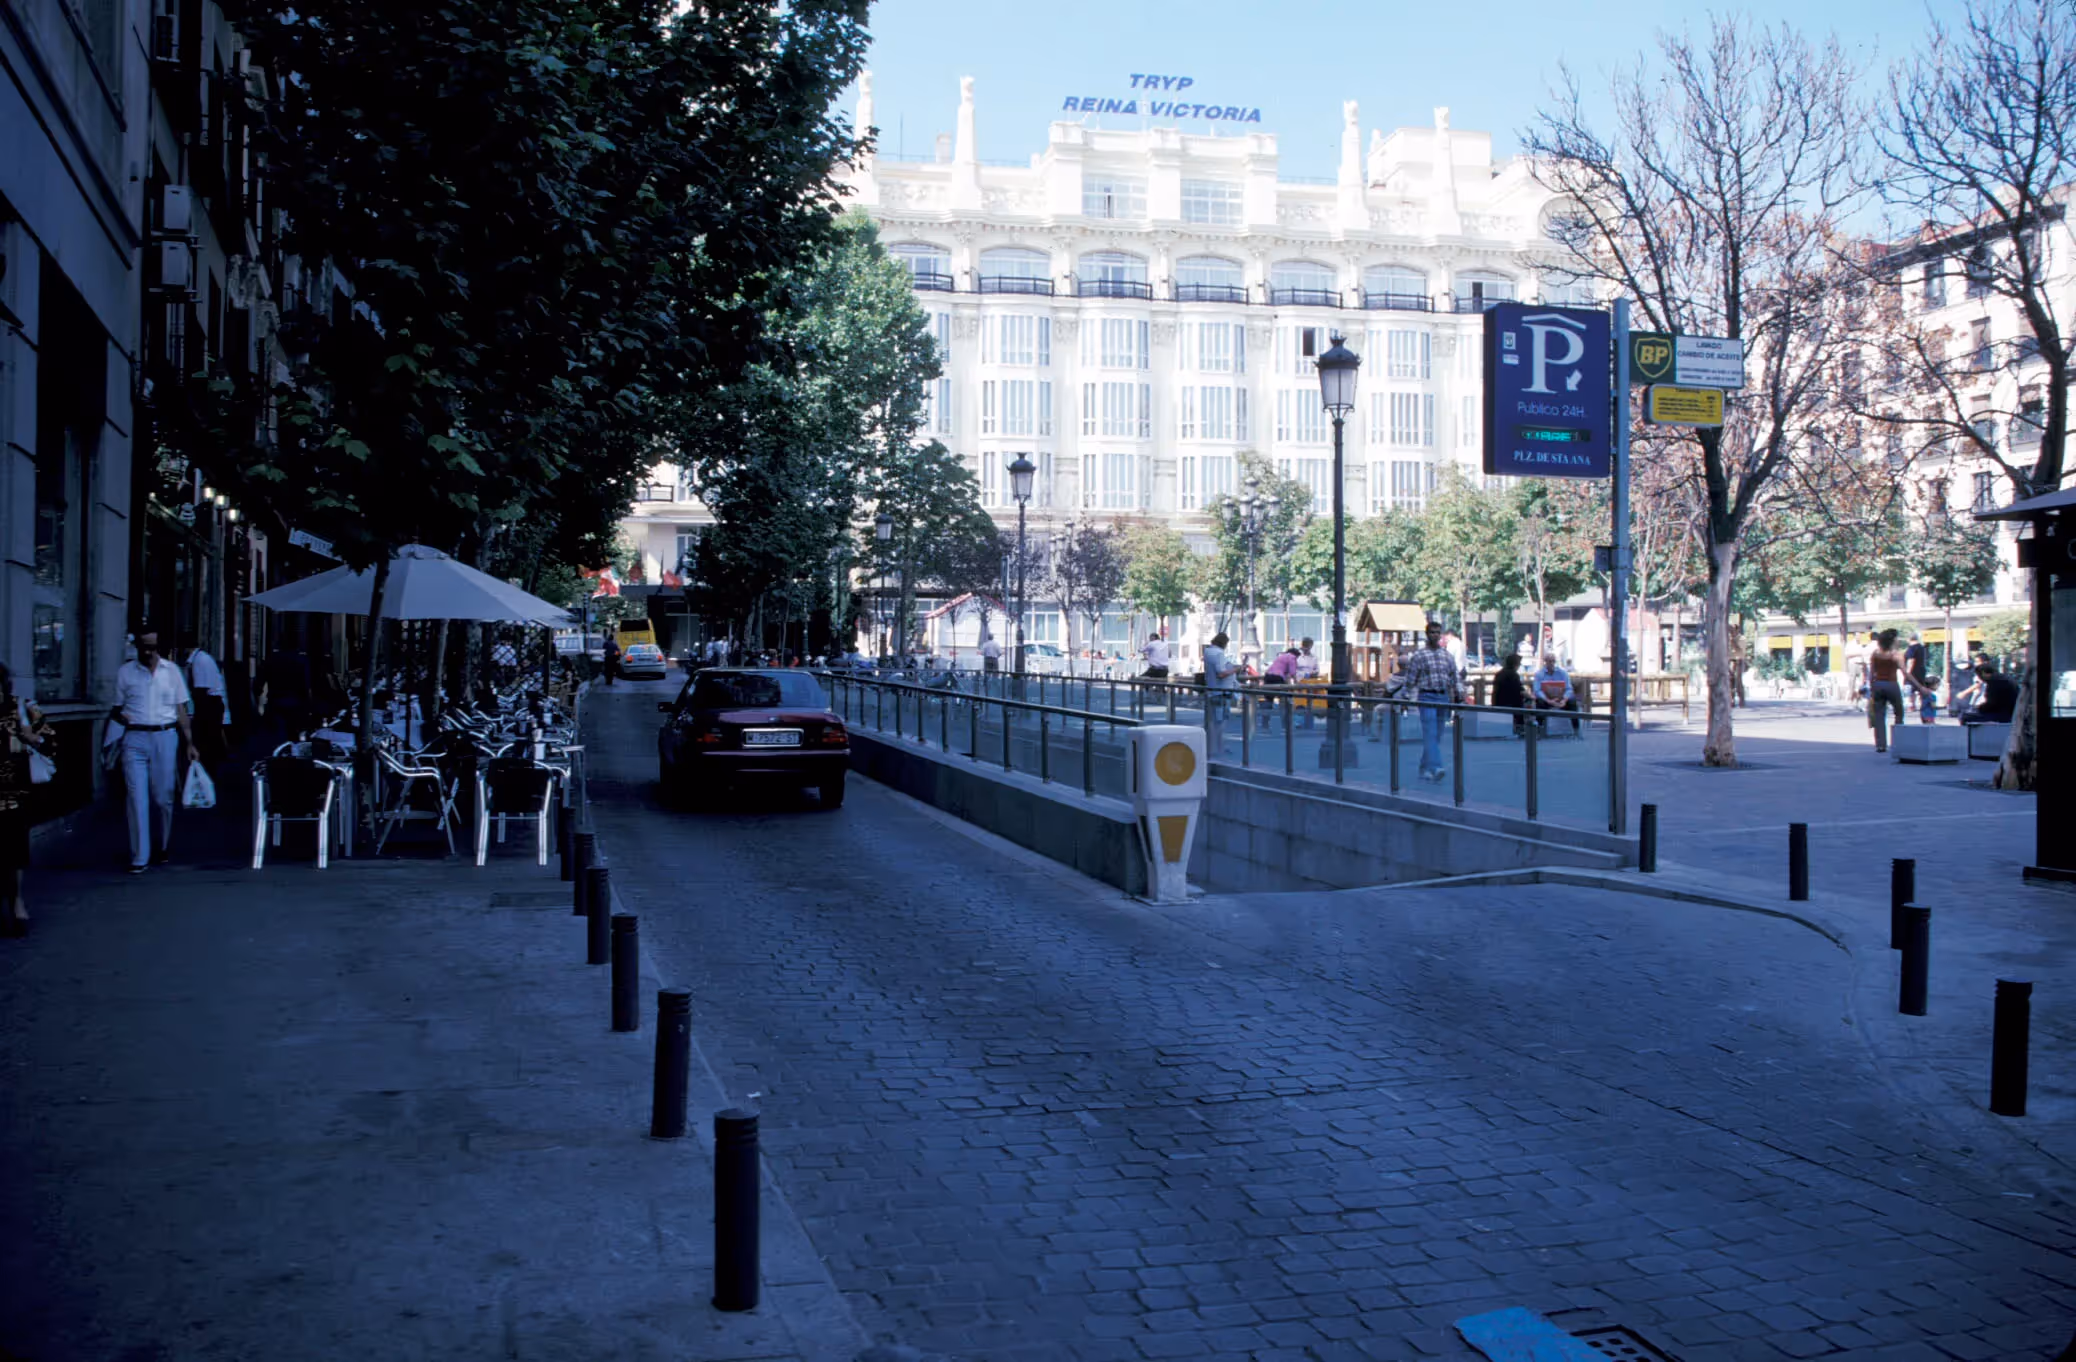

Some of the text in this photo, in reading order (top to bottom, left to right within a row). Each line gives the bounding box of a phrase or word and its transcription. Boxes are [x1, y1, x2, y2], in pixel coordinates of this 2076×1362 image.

[1129, 73, 1194, 91] TRYP
[1062, 96, 1261, 123] REINA VICTORIA
[1521, 323, 1584, 394] P
[1640, 345, 1669, 365] BP
[1571, 455, 1592, 466] ANA
